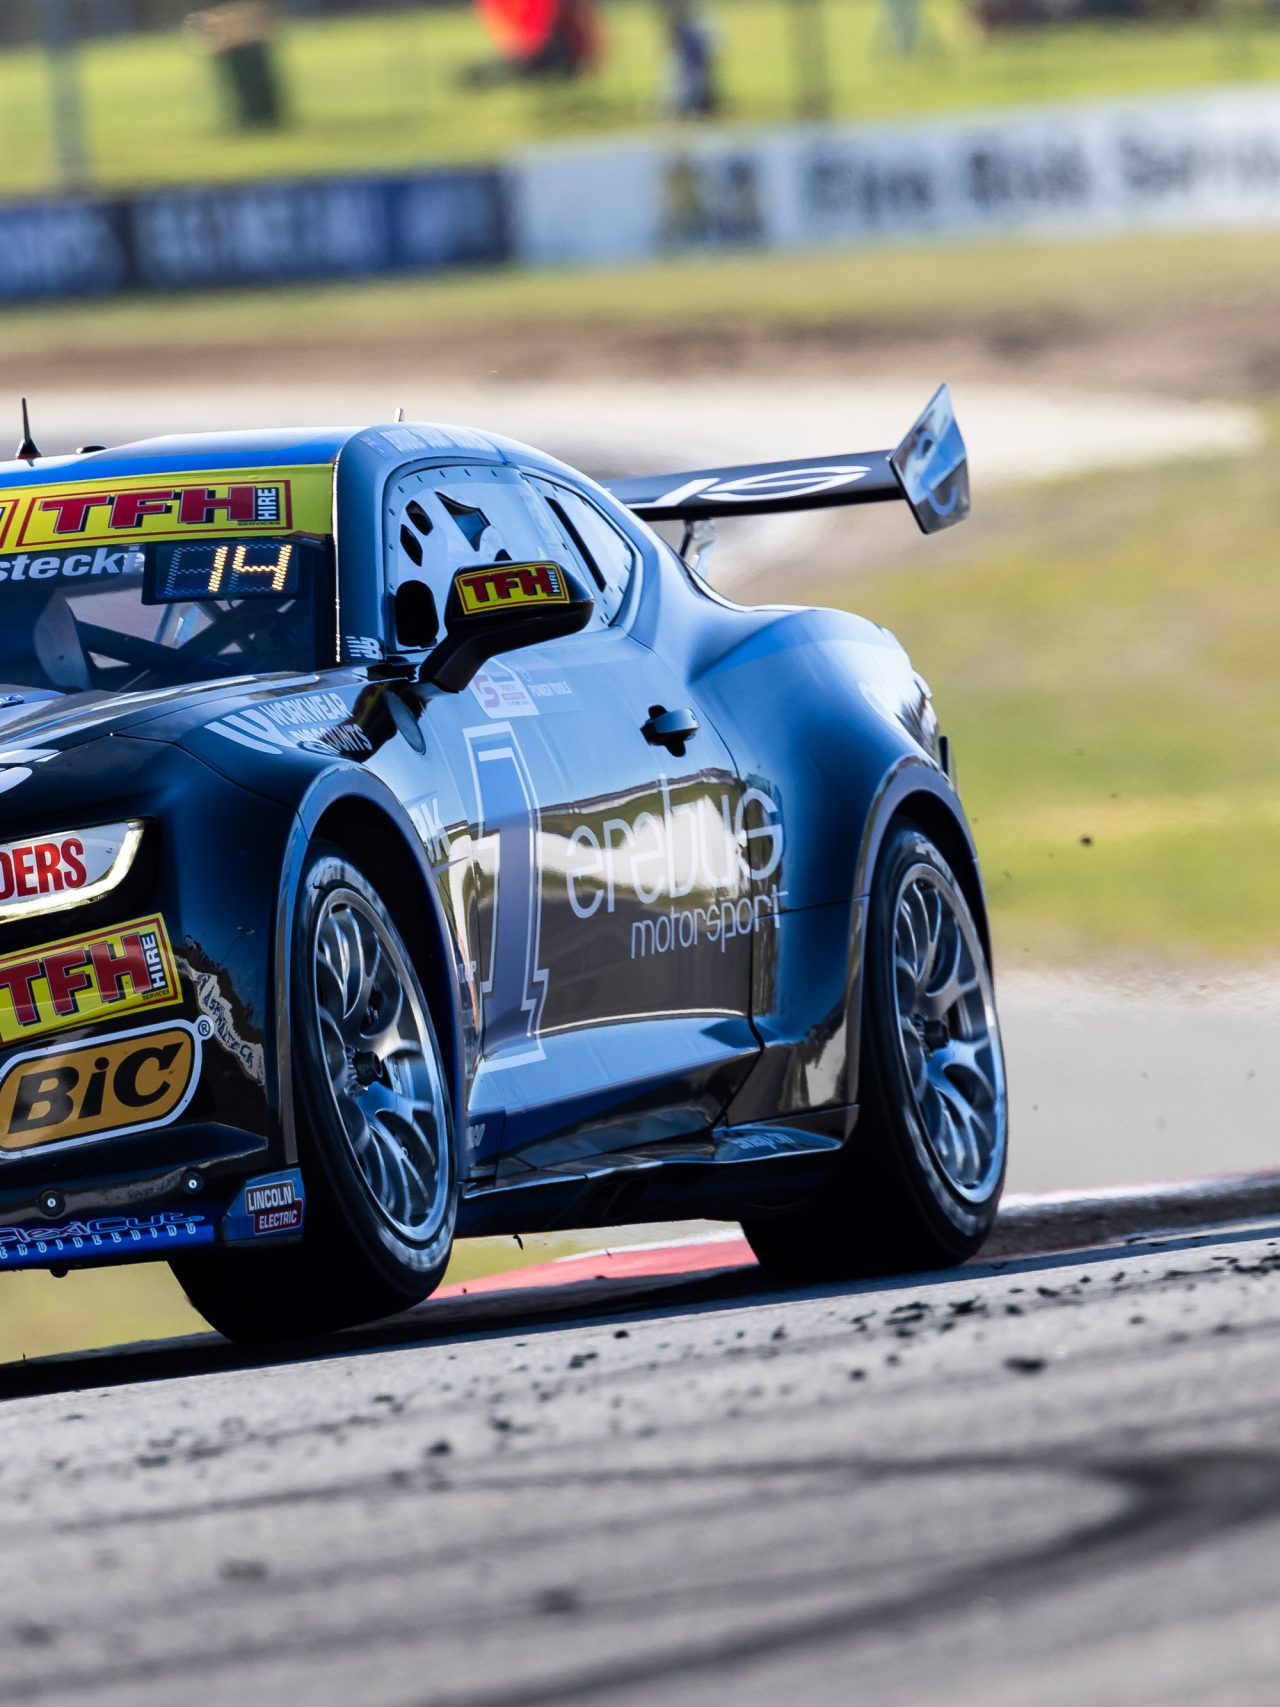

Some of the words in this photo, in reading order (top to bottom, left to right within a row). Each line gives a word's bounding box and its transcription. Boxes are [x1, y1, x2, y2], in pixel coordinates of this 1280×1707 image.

[40, 486, 256, 534] TFH
[258, 488, 277, 520] HIRE
[208, 543, 292, 593] 14
[462, 566, 553, 603] TFH
[547, 568, 560, 593] HIRE
[258, 693, 353, 726] WORKWEAR
[631, 884, 789, 960] motorsport
[142, 935, 166, 989] HIRE
[143, 989, 170, 1001] SERVICES
[7, 1042, 184, 1135] BiC
[247, 1186, 293, 1211] LINCOLN
[259, 1209, 298, 1230] ELECTRIC
